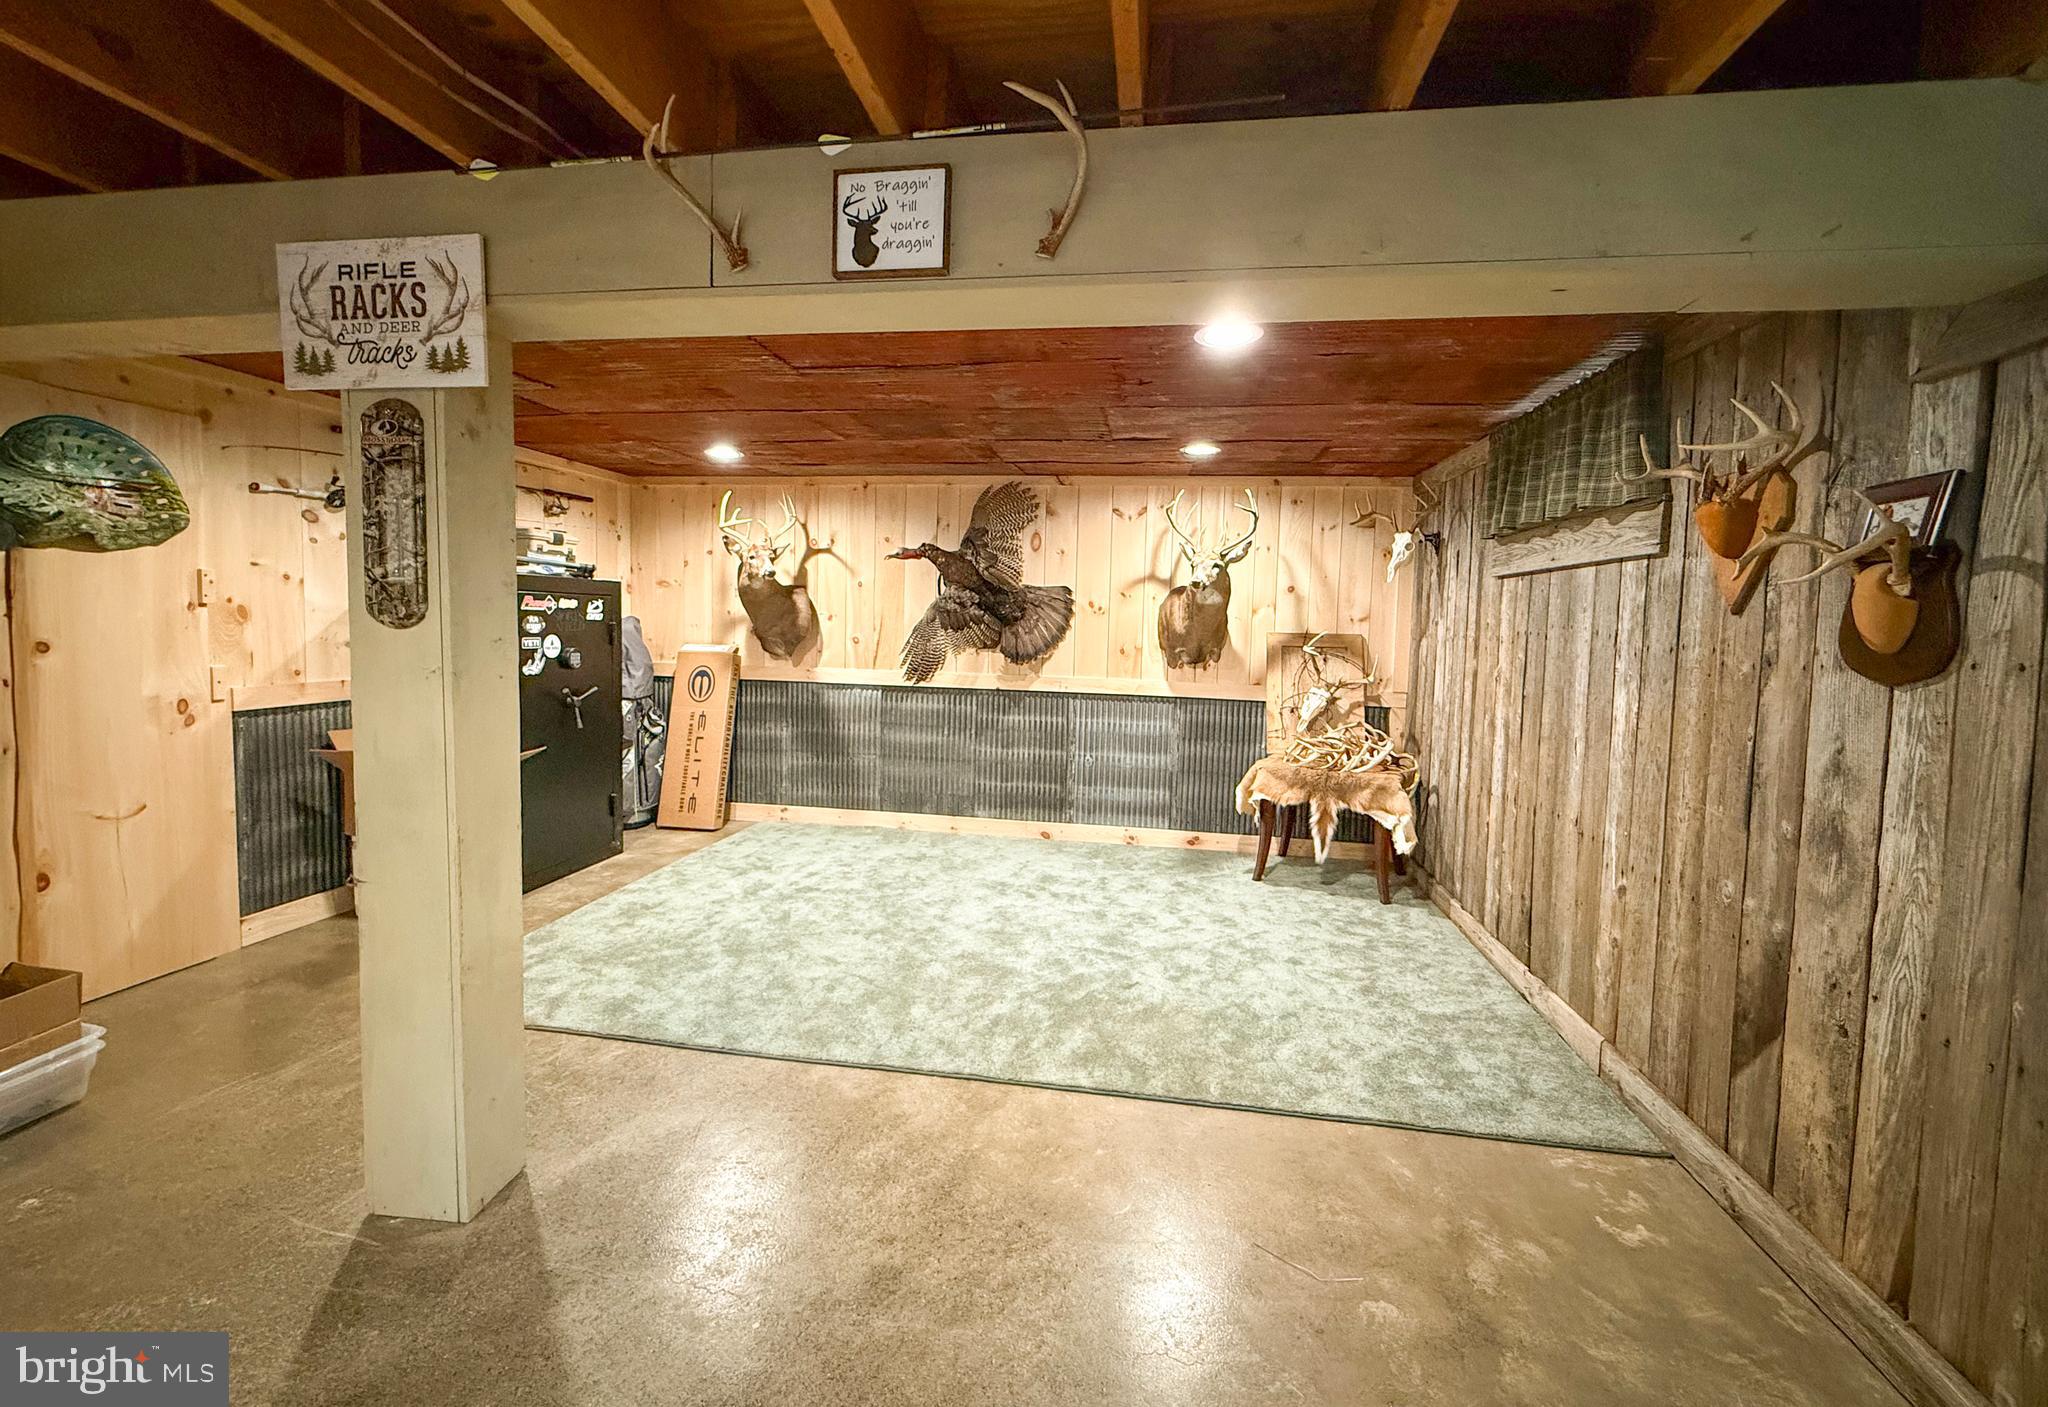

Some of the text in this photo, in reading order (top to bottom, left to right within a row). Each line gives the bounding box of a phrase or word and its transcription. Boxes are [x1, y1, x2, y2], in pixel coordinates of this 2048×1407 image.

[850, 175, 931, 195] No Braggin'
[896, 199, 917, 212] 'till
[890, 217, 930, 233] you're
[881, 234, 935, 253] draggin'
[337, 261, 417, 281] RIFLE
[329, 281, 427, 321] RACKS
[340, 320, 422, 335] AND DEER
[523, 639, 540, 647] YETI
[688, 710, 706, 814] ELITE
